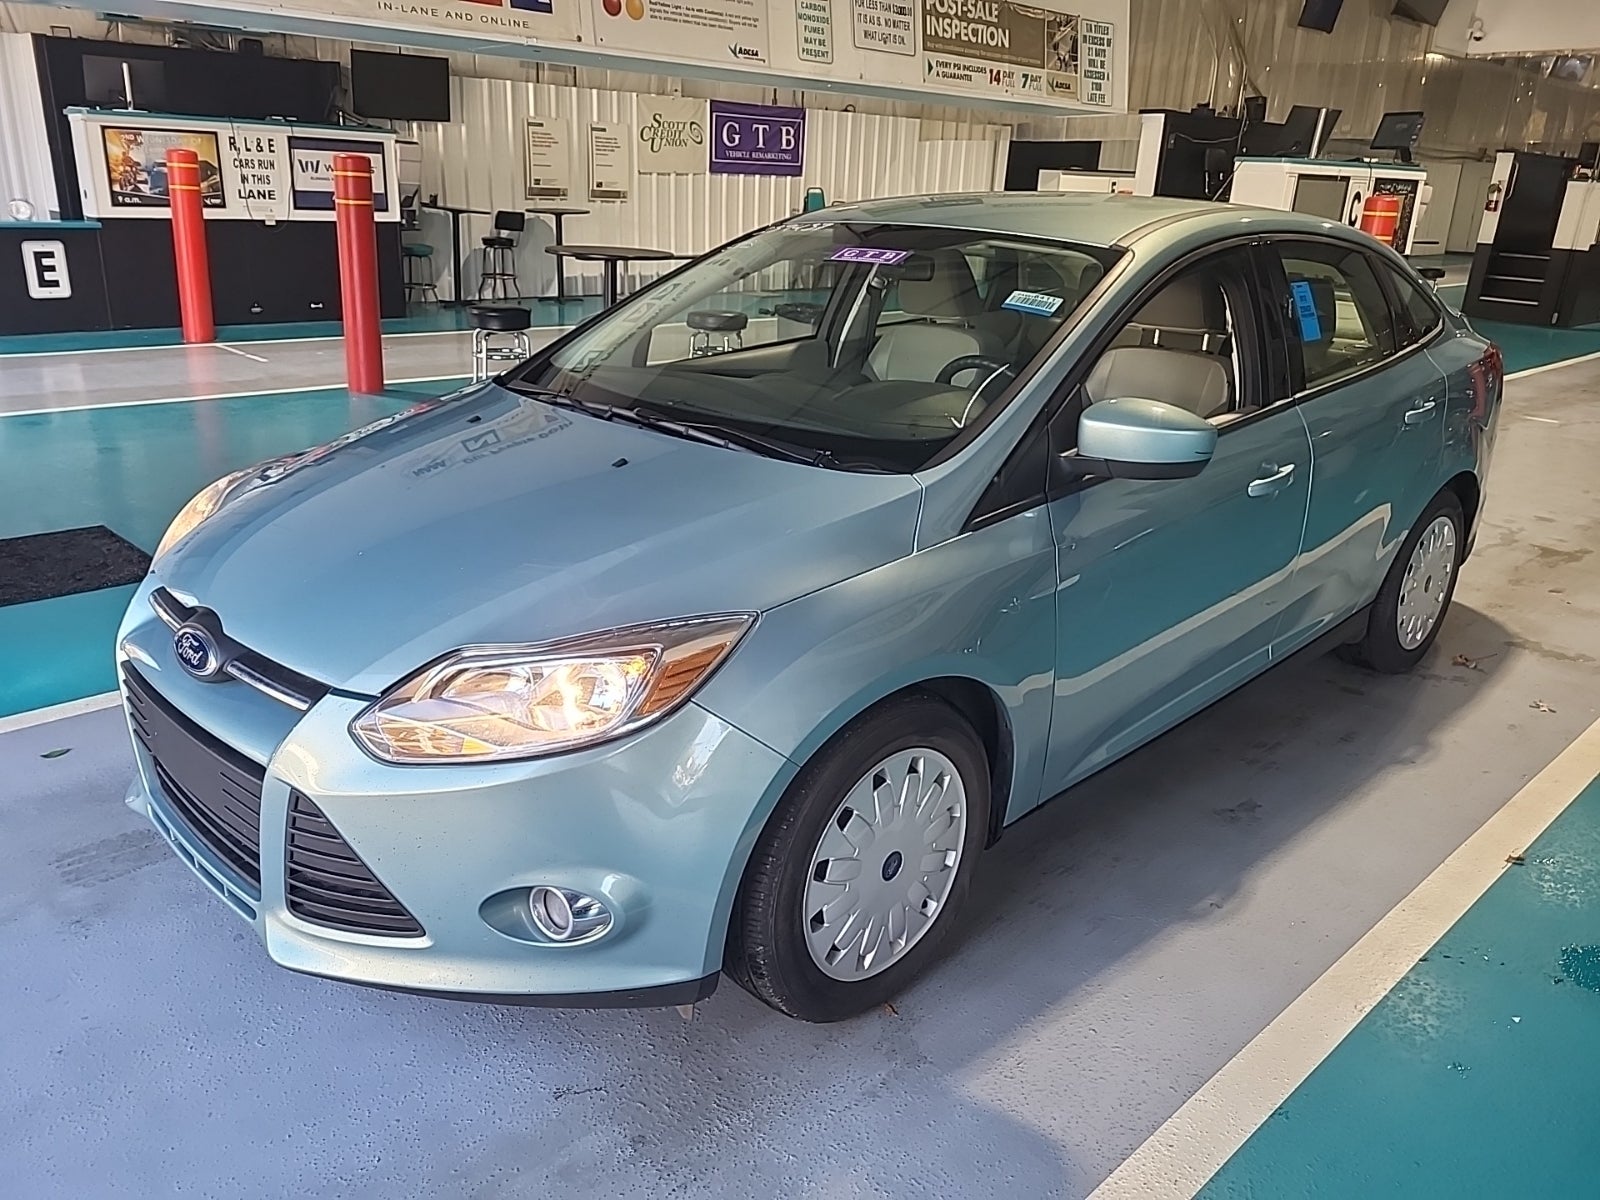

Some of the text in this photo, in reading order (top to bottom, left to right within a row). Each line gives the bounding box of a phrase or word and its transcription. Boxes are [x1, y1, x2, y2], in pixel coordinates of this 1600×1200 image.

[801, 2, 827, 13] CARBON
[866, 0, 878, 10] LESS
[879, 1, 892, 13] THAN
[926, 0, 999, 23] POST-SALE
[377, 1, 530, 29] IN-LANE AND ONLINE
[798, 13, 830, 25] MONOXIDE
[804, 24, 825, 35] FUMES
[893, 19, 910, 31] MATTER
[926, 15, 1010, 48] INSPECTION
[804, 36, 826, 47] MAY BE
[863, 29, 877, 41] WHAT
[802, 47, 829, 59] PRESENT
[936, 60, 952, 70] EVERY
[962, 64, 987, 74] INCLUDES
[941, 71, 972, 82] GUARANTEE
[989, 68, 1015, 85] 14 DAY
[1002, 78, 1015, 88] FULL
[1021, 73, 1042, 89] 7 DAY
[1029, 82, 1041, 91] FULL
[651, 113, 688, 130] SCOTT
[640, 126, 684, 142] CREDIT
[244, 137, 251, 152] L
[255, 137, 264, 152] &
[268, 138, 275, 153] E
[650, 137, 688, 153] UNION
[233, 158, 275, 170] CARS RUN
[240, 174, 271, 185] IN THIS
[238, 189, 276, 200] LANE
[1348, 190, 1362, 227] C
[33, 251, 60, 288] E
[178, 633, 204, 666] Ford
